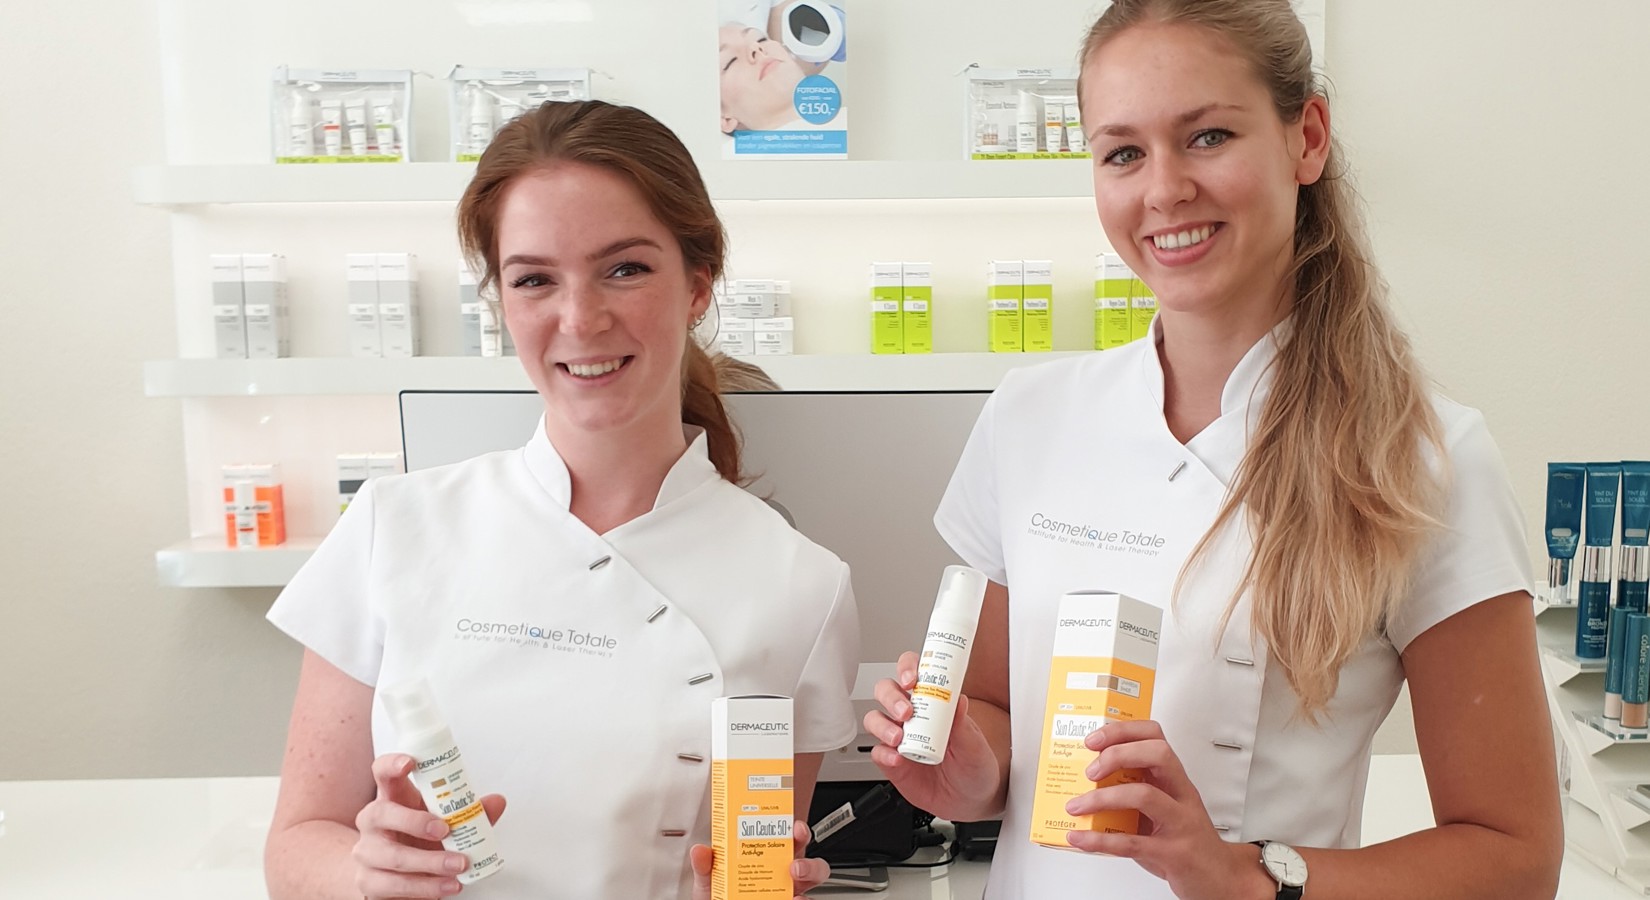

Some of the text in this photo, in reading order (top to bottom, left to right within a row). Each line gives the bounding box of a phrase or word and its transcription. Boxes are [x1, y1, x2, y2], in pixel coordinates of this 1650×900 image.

[798, 103, 836, 115] €150,-
[1031, 513, 1166, 548] Cosmetique Totale
[1028, 527, 1056, 541] Institute
[1058, 535, 1068, 543] for
[1070, 538, 1094, 549] Health
[1105, 543, 1126, 552] Laser
[1059, 619, 1112, 628] DERMACEUTIC
[1119, 620, 1159, 640] DERMACEUTIC
[457, 618, 617, 650] Cosmetique Totale
[938, 673, 950, 686] 50+
[730, 723, 789, 731] DERMACEUTIC
[1056, 720, 1067, 736] Sun
[1068, 720, 1086, 737] Ceutic
[906, 733, 931, 742] PROTECT
[742, 820, 754, 837] Sun
[756, 820, 776, 836] Ceutic
[1045, 819, 1077, 828] PROTÉGER
[742, 848, 764, 857] Anti-Âge
[473, 852, 498, 868] PROTECT
